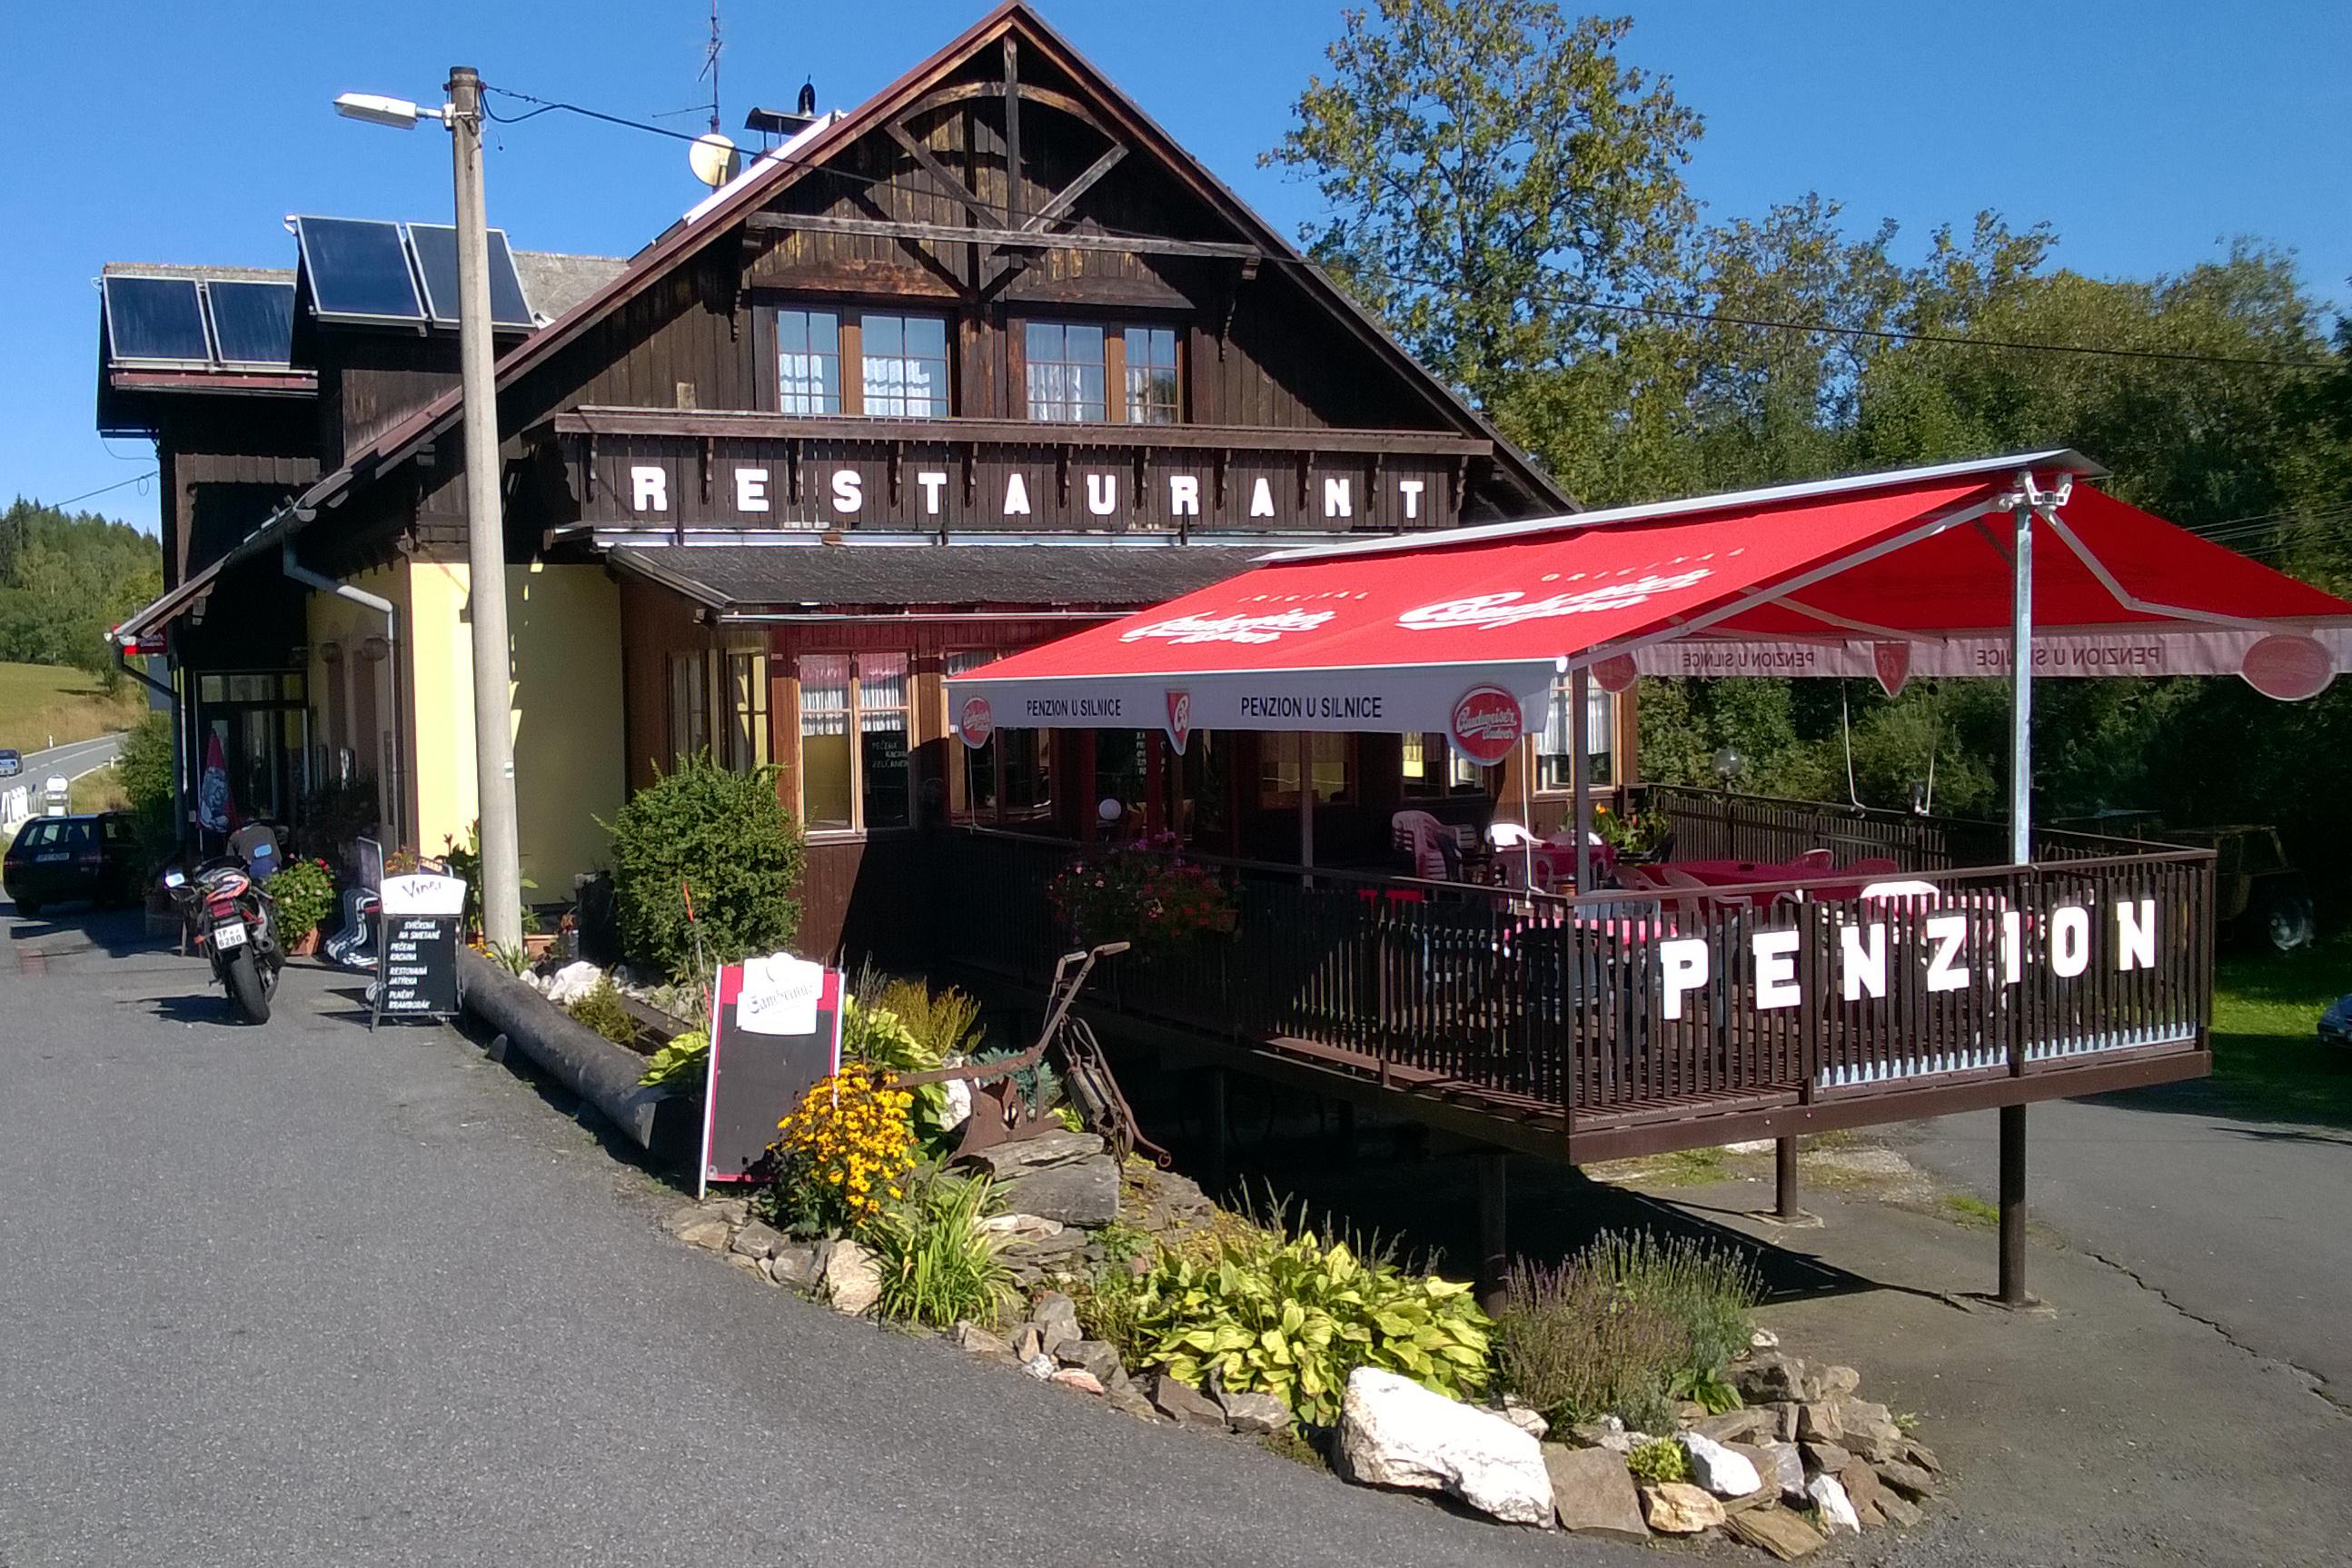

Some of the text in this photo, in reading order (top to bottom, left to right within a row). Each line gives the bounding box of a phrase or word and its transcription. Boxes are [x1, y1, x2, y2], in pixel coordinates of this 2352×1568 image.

[630, 466, 1424, 519] RESTAURANT
[1027, 699, 1122, 717] PENZION U SILNICE
[1241, 696, 1383, 718] PENZION U SILNICE
[1455, 706, 1518, 738] Budweiser
[1660, 899, 2156, 1020] PENZION
